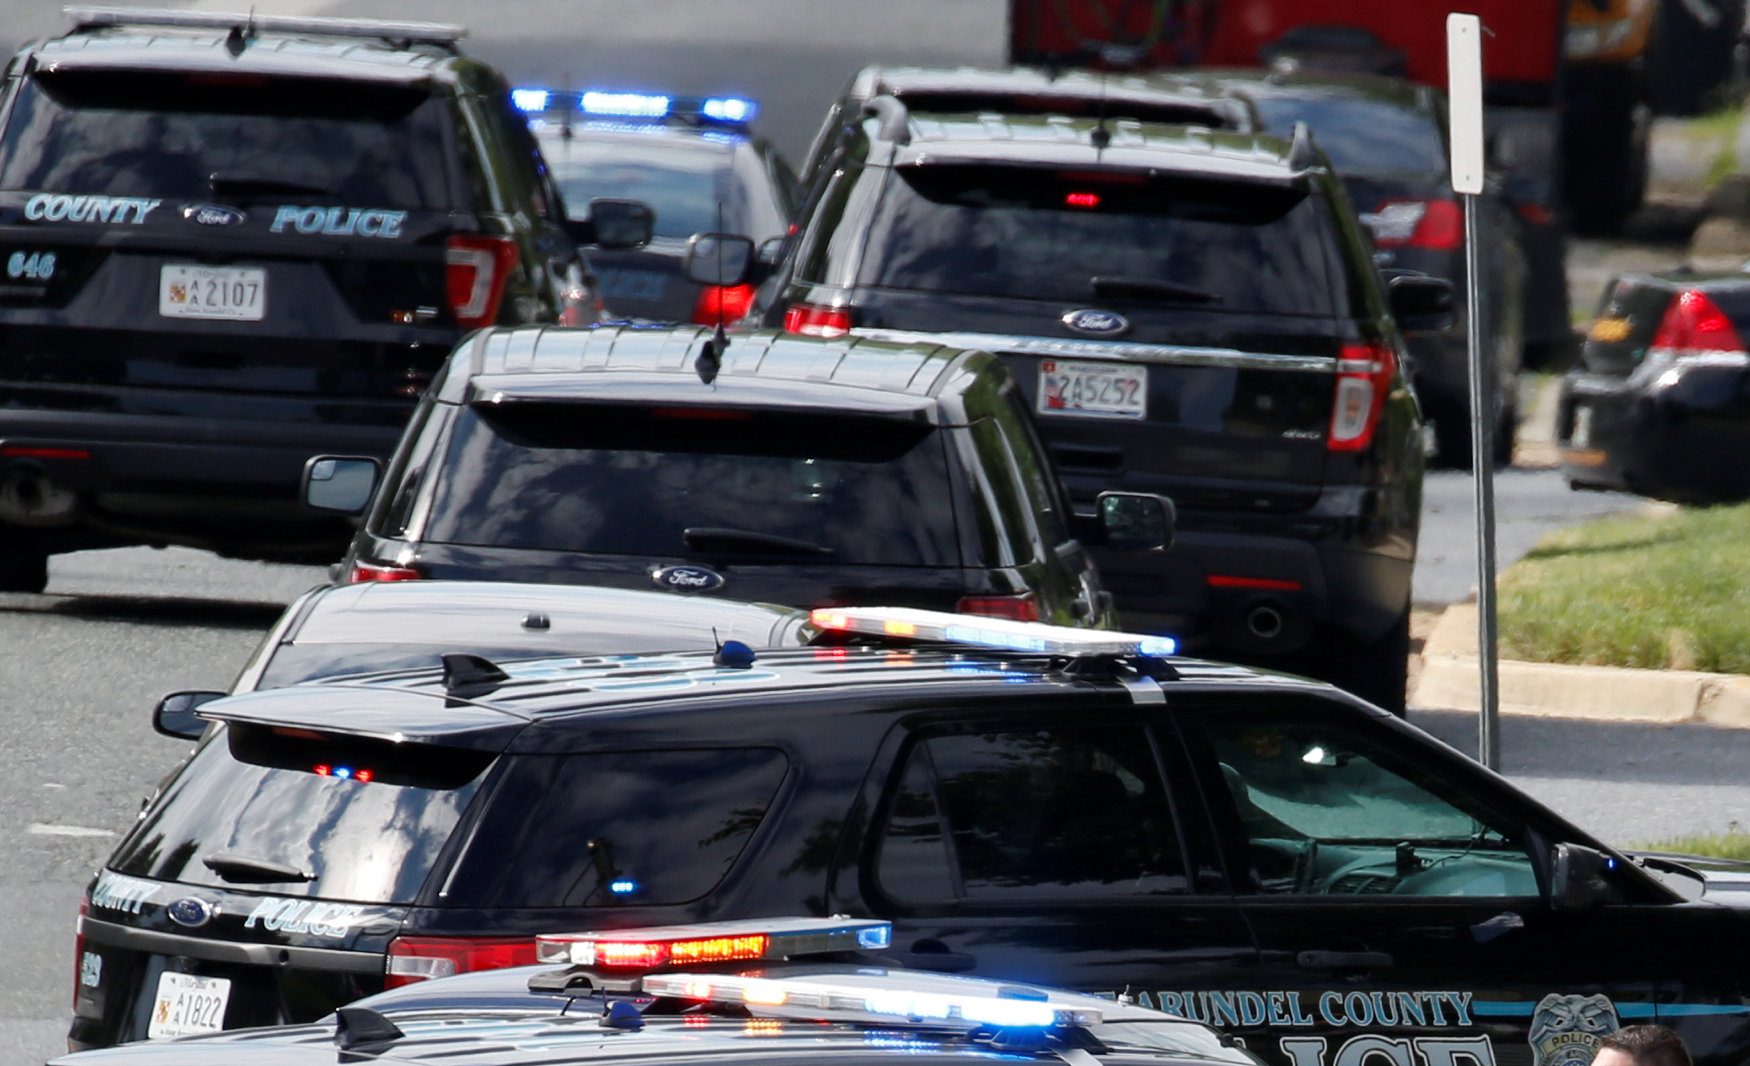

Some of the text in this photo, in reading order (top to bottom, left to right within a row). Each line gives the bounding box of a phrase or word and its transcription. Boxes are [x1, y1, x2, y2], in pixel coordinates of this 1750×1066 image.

[25, 193, 162, 225] COUNTY
[270, 204, 408, 238] POLICE
[206, 280, 258, 307] 2107
[668, 569, 708, 586] Ford
[244, 897, 365, 938] POLICE
[183, 995, 222, 1028] 1822
[1318, 991, 1473, 1027] COUNTY
[1551, 1034, 1600, 1049] POLICE
